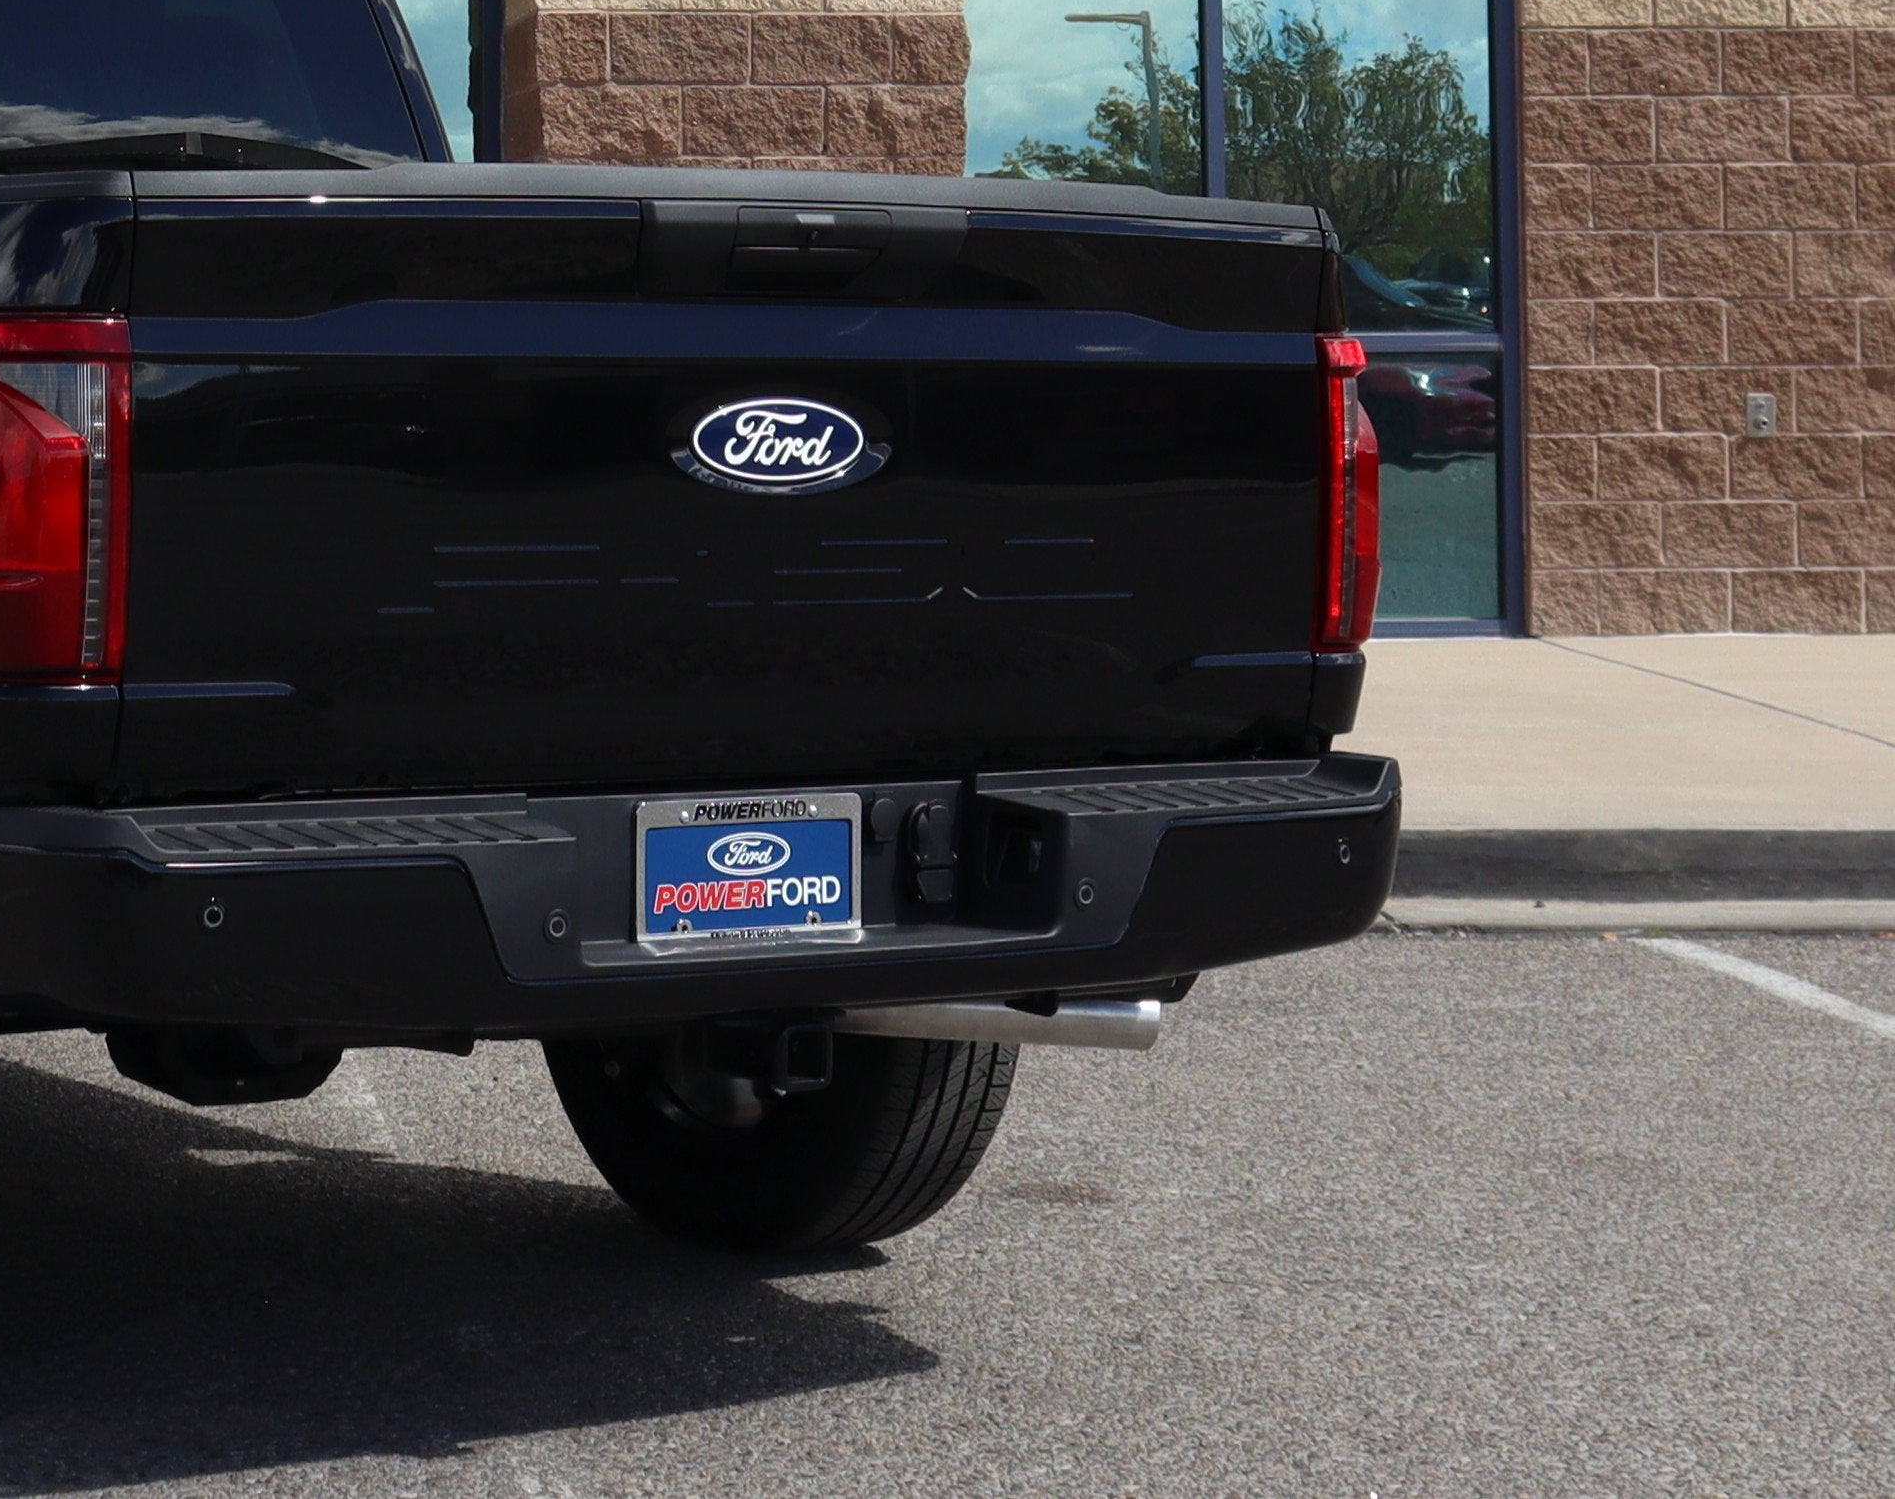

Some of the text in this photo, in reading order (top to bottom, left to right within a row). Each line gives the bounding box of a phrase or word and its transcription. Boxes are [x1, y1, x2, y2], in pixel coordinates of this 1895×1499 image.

[724, 410, 834, 466] Ford
[693, 799, 807, 822] POWERFORD
[723, 840, 773, 866] Ford
[653, 875, 842, 915] POWERFORD
